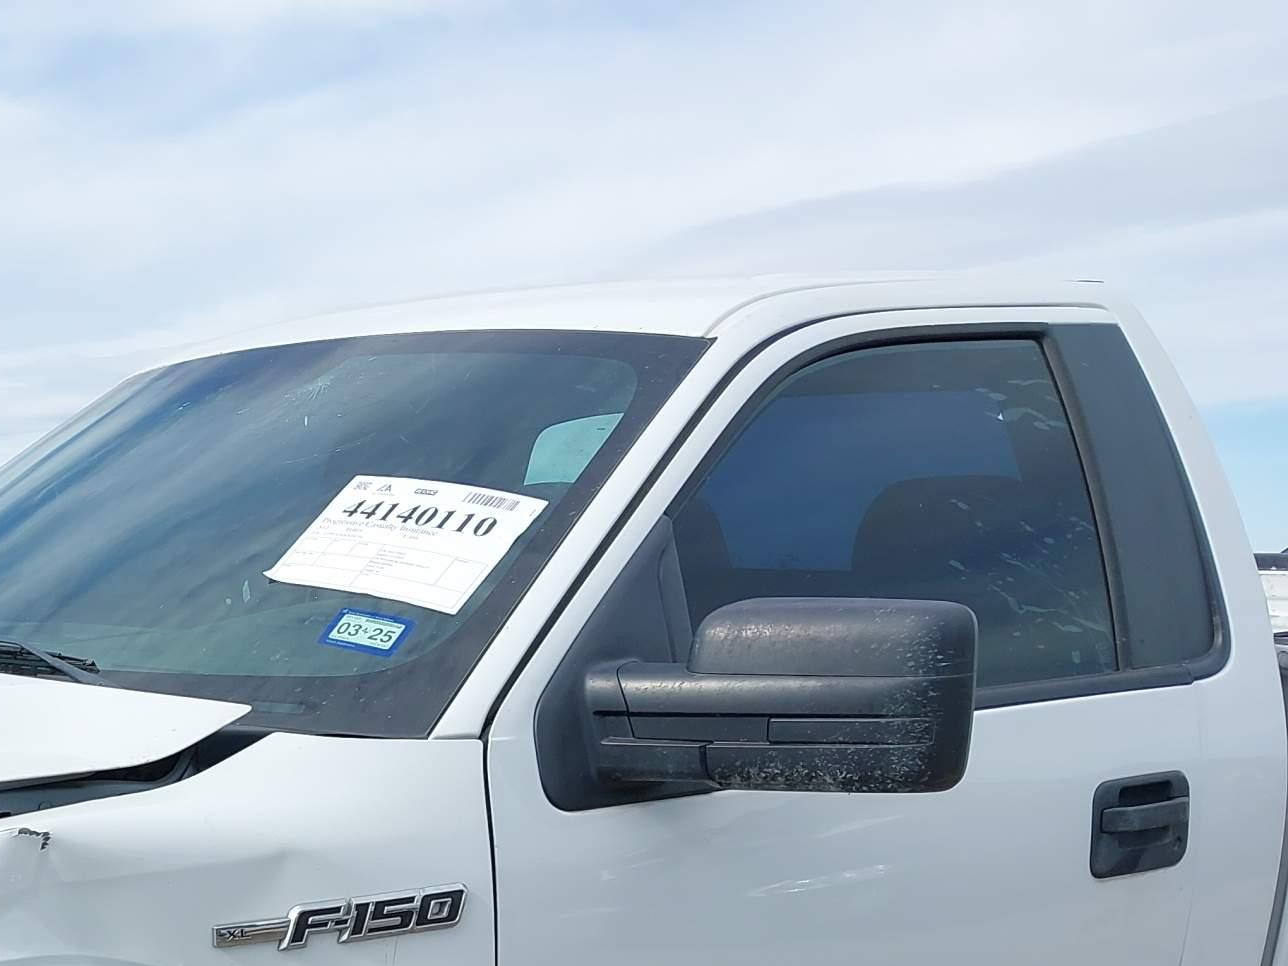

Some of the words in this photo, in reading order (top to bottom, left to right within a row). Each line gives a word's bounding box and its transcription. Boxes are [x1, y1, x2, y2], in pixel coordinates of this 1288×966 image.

[342, 499, 498, 538] 44140110
[337, 622, 362, 637] 03
[367, 627, 396, 643] 25
[227, 928, 252, 940] XL
[277, 882, 469, 951] F-150
